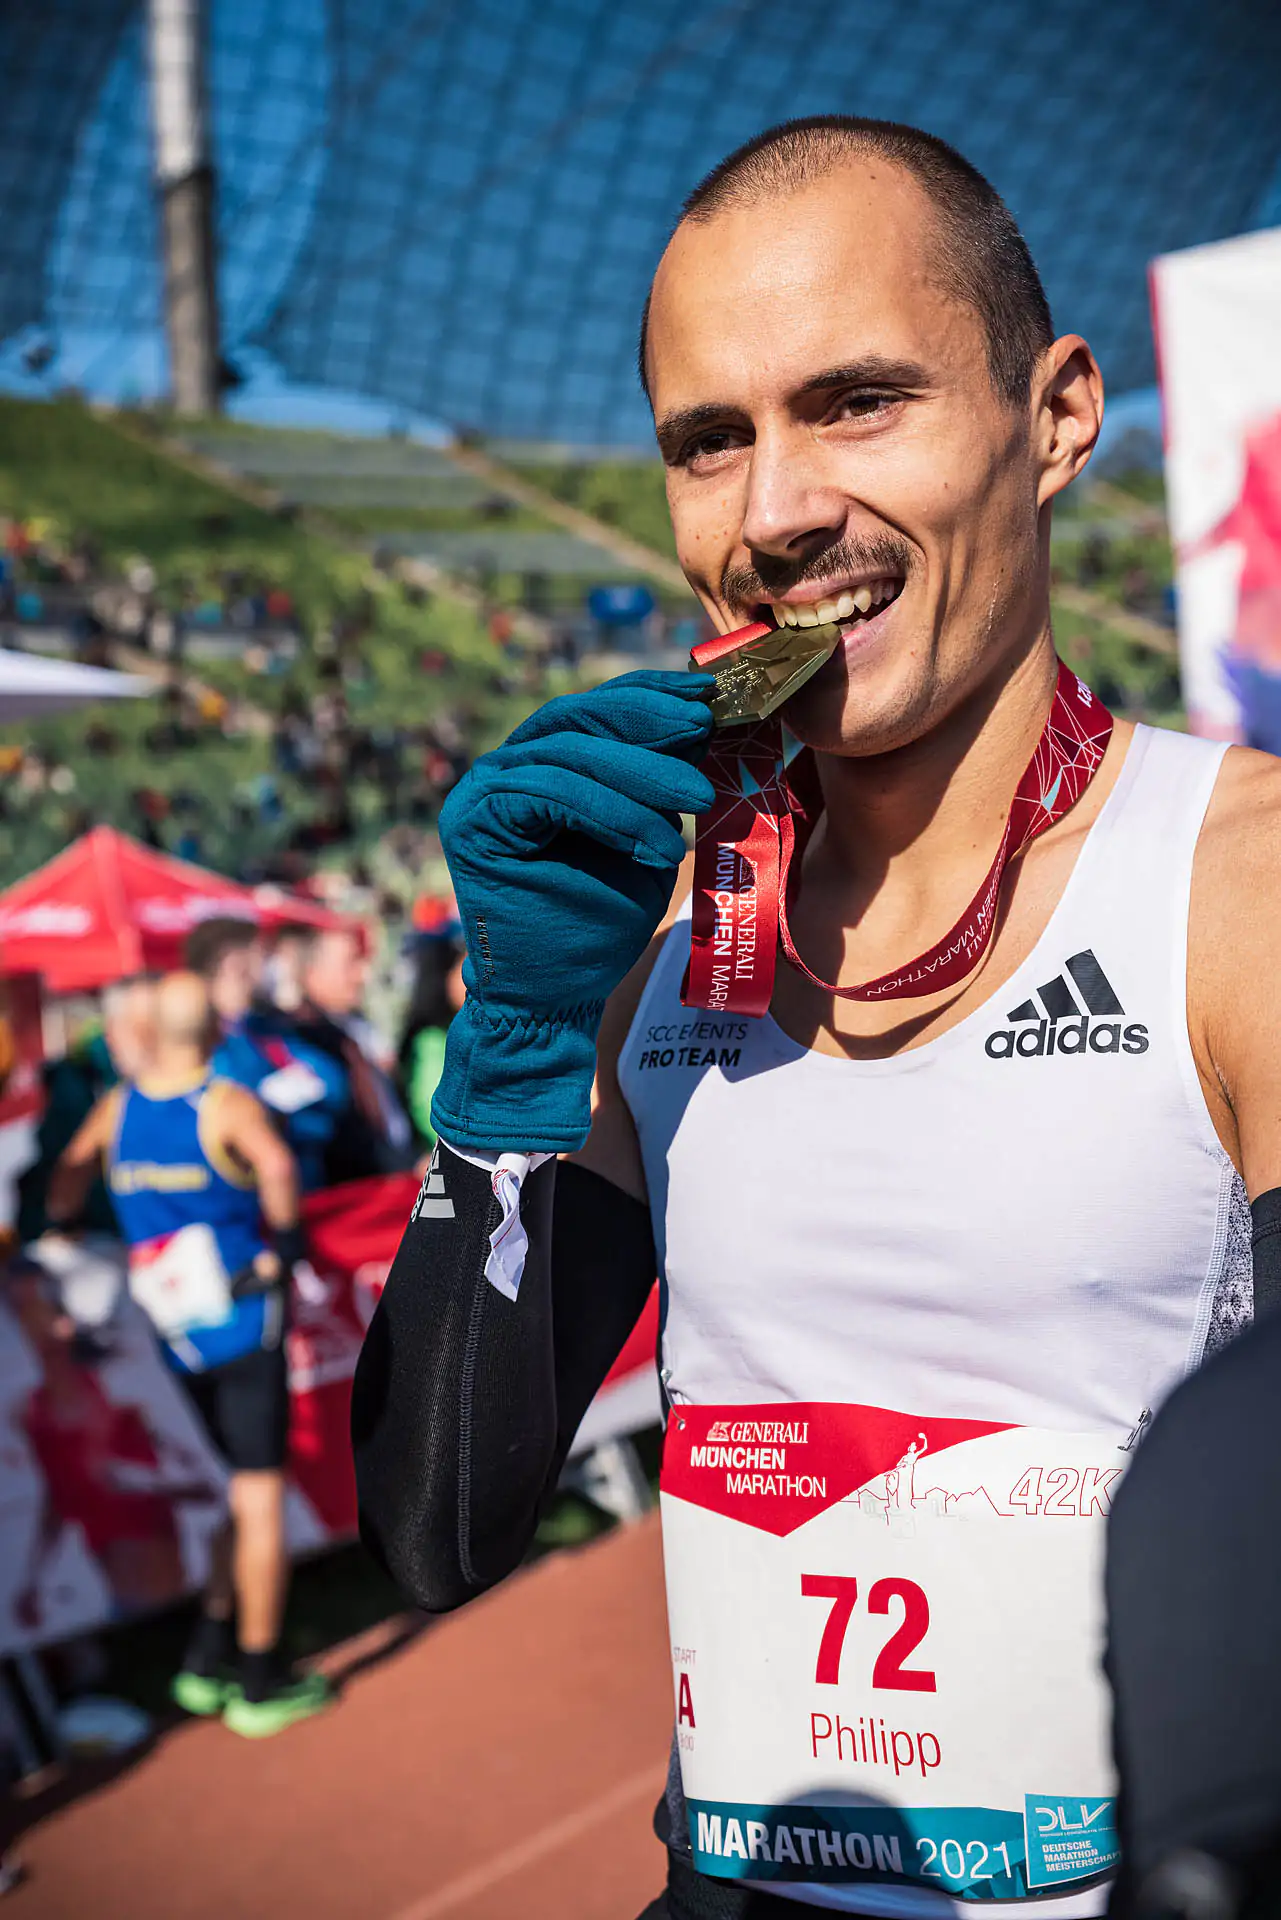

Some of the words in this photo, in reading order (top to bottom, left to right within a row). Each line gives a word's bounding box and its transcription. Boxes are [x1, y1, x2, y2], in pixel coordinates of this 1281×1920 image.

[713, 842, 736, 956] MÜNCHEN
[735, 884, 758, 980] GENERALI
[866, 925, 975, 997] MARATHON
[645, 1025, 676, 1043] SCC
[985, 1015, 1149, 1059] adidas
[731, 1422, 809, 1444] GENERALI
[690, 1446, 786, 1470] MÜNCHEN
[726, 1474, 826, 1498] MARATHON
[801, 1574, 937, 1693] 72
[679, 1672, 696, 1728] A
[810, 1712, 942, 1777] Philipp
[1035, 1802, 1112, 1832] DLV
[698, 1811, 904, 1873] MARATHON
[915, 1837, 1012, 1879] 2021
[1042, 1840, 1092, 1853] DEUTSCHE
[1044, 1848, 1098, 1863] MARATHON
